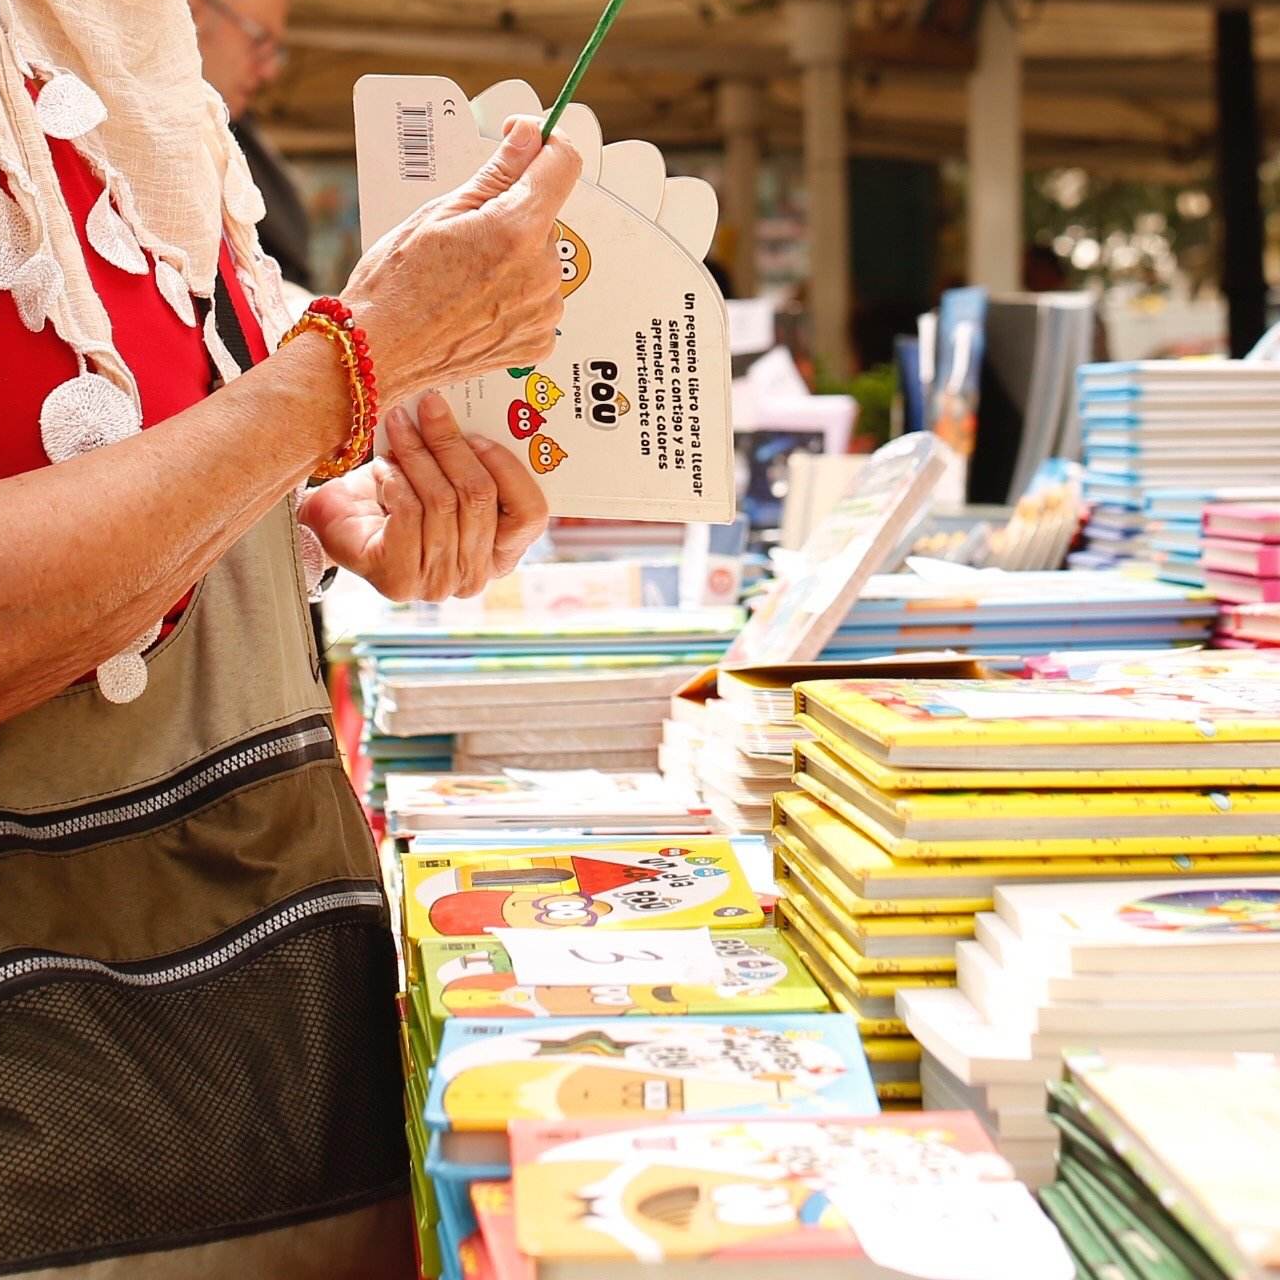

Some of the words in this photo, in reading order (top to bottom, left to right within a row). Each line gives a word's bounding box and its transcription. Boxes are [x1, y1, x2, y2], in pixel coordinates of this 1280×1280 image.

[650, 318, 665, 385] aprender
[668, 320, 682, 374] siempre
[571, 363, 583, 420] www.pou.me
[634, 331, 651, 427] divirtiéndote
[654, 389, 666, 411] los
[688, 377, 700, 411] libro
[671, 378, 683, 432] contigo
[640, 431, 651, 456] con
[656, 415, 669, 470] colores
[672, 437, 683, 445] y
[688, 416, 701, 449] para
[691, 453, 704, 497] llevar
